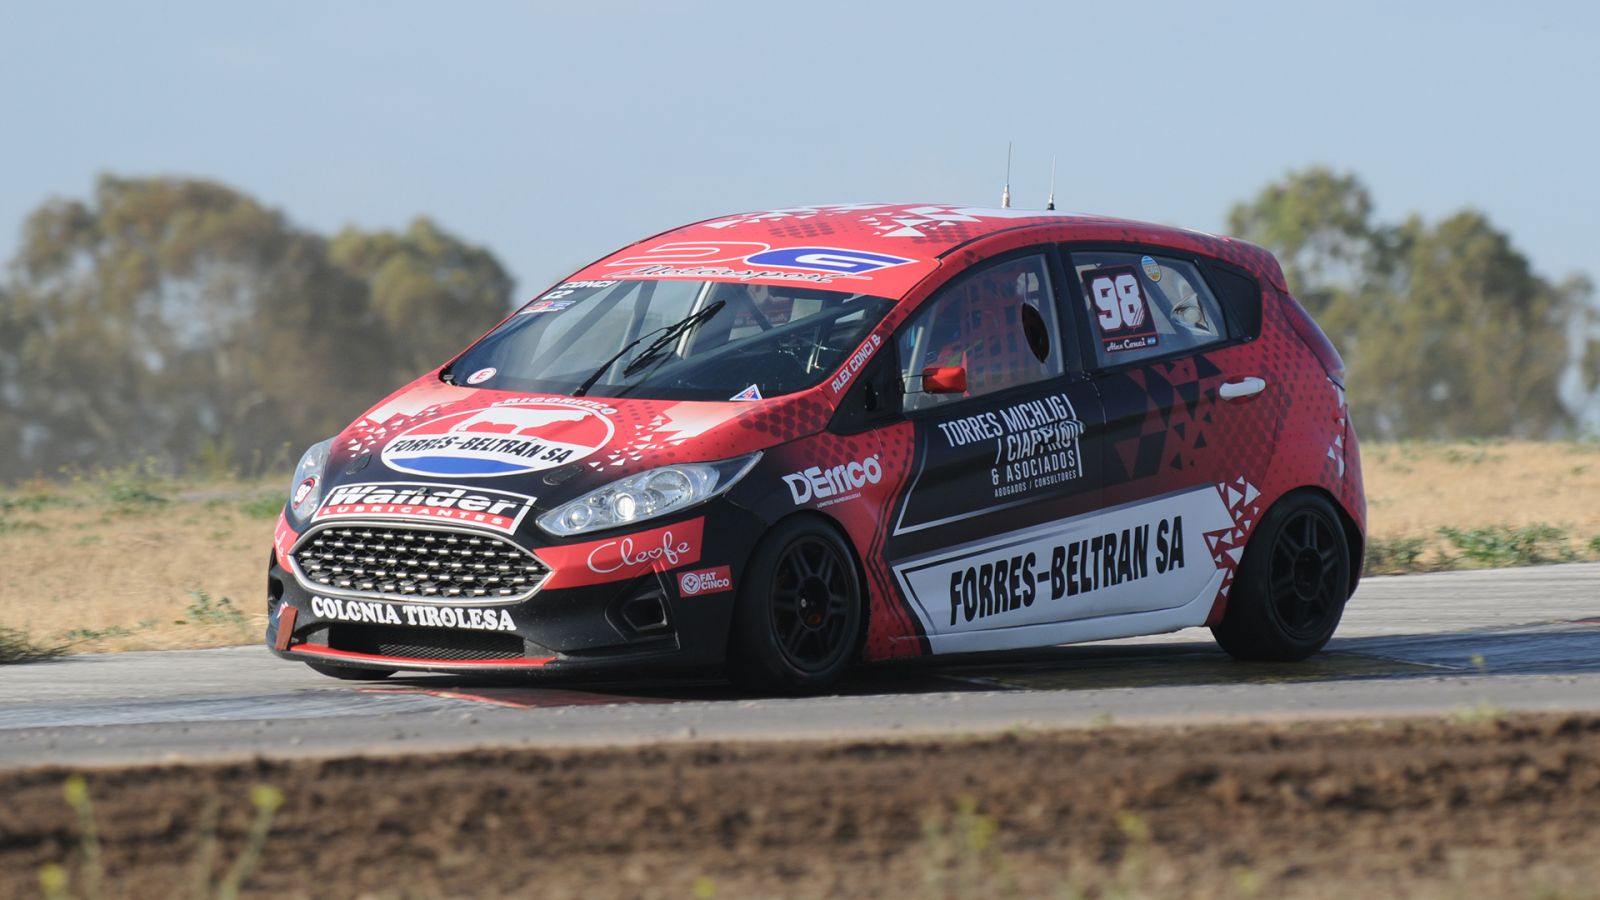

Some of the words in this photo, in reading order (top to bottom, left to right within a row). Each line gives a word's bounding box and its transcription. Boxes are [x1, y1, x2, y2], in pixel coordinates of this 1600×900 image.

[1092, 274, 1144, 330] 98
[831, 367, 852, 394] ALEX
[849, 341, 874, 372] CONCI
[938, 412, 1003, 447] TORRES
[999, 395, 1068, 433] MICHLIG
[540, 448, 574, 464] SA
[991, 468, 999, 486] &
[1006, 450, 1076, 483] ASOCIADOS
[994, 482, 1027, 498] ABOGADOS
[1034, 469, 1077, 488] CONSULTORES
[322, 503, 503, 525] LUBRICANTES
[328, 485, 518, 515] Wander
[700, 571, 717, 581] FAT
[701, 578, 730, 590] CINCO
[950, 523, 1149, 626] FORRES-BELTRAN
[1155, 515, 1185, 574] SA
[311, 596, 401, 625] COLONIA
[402, 605, 517, 631] TIROLESA
